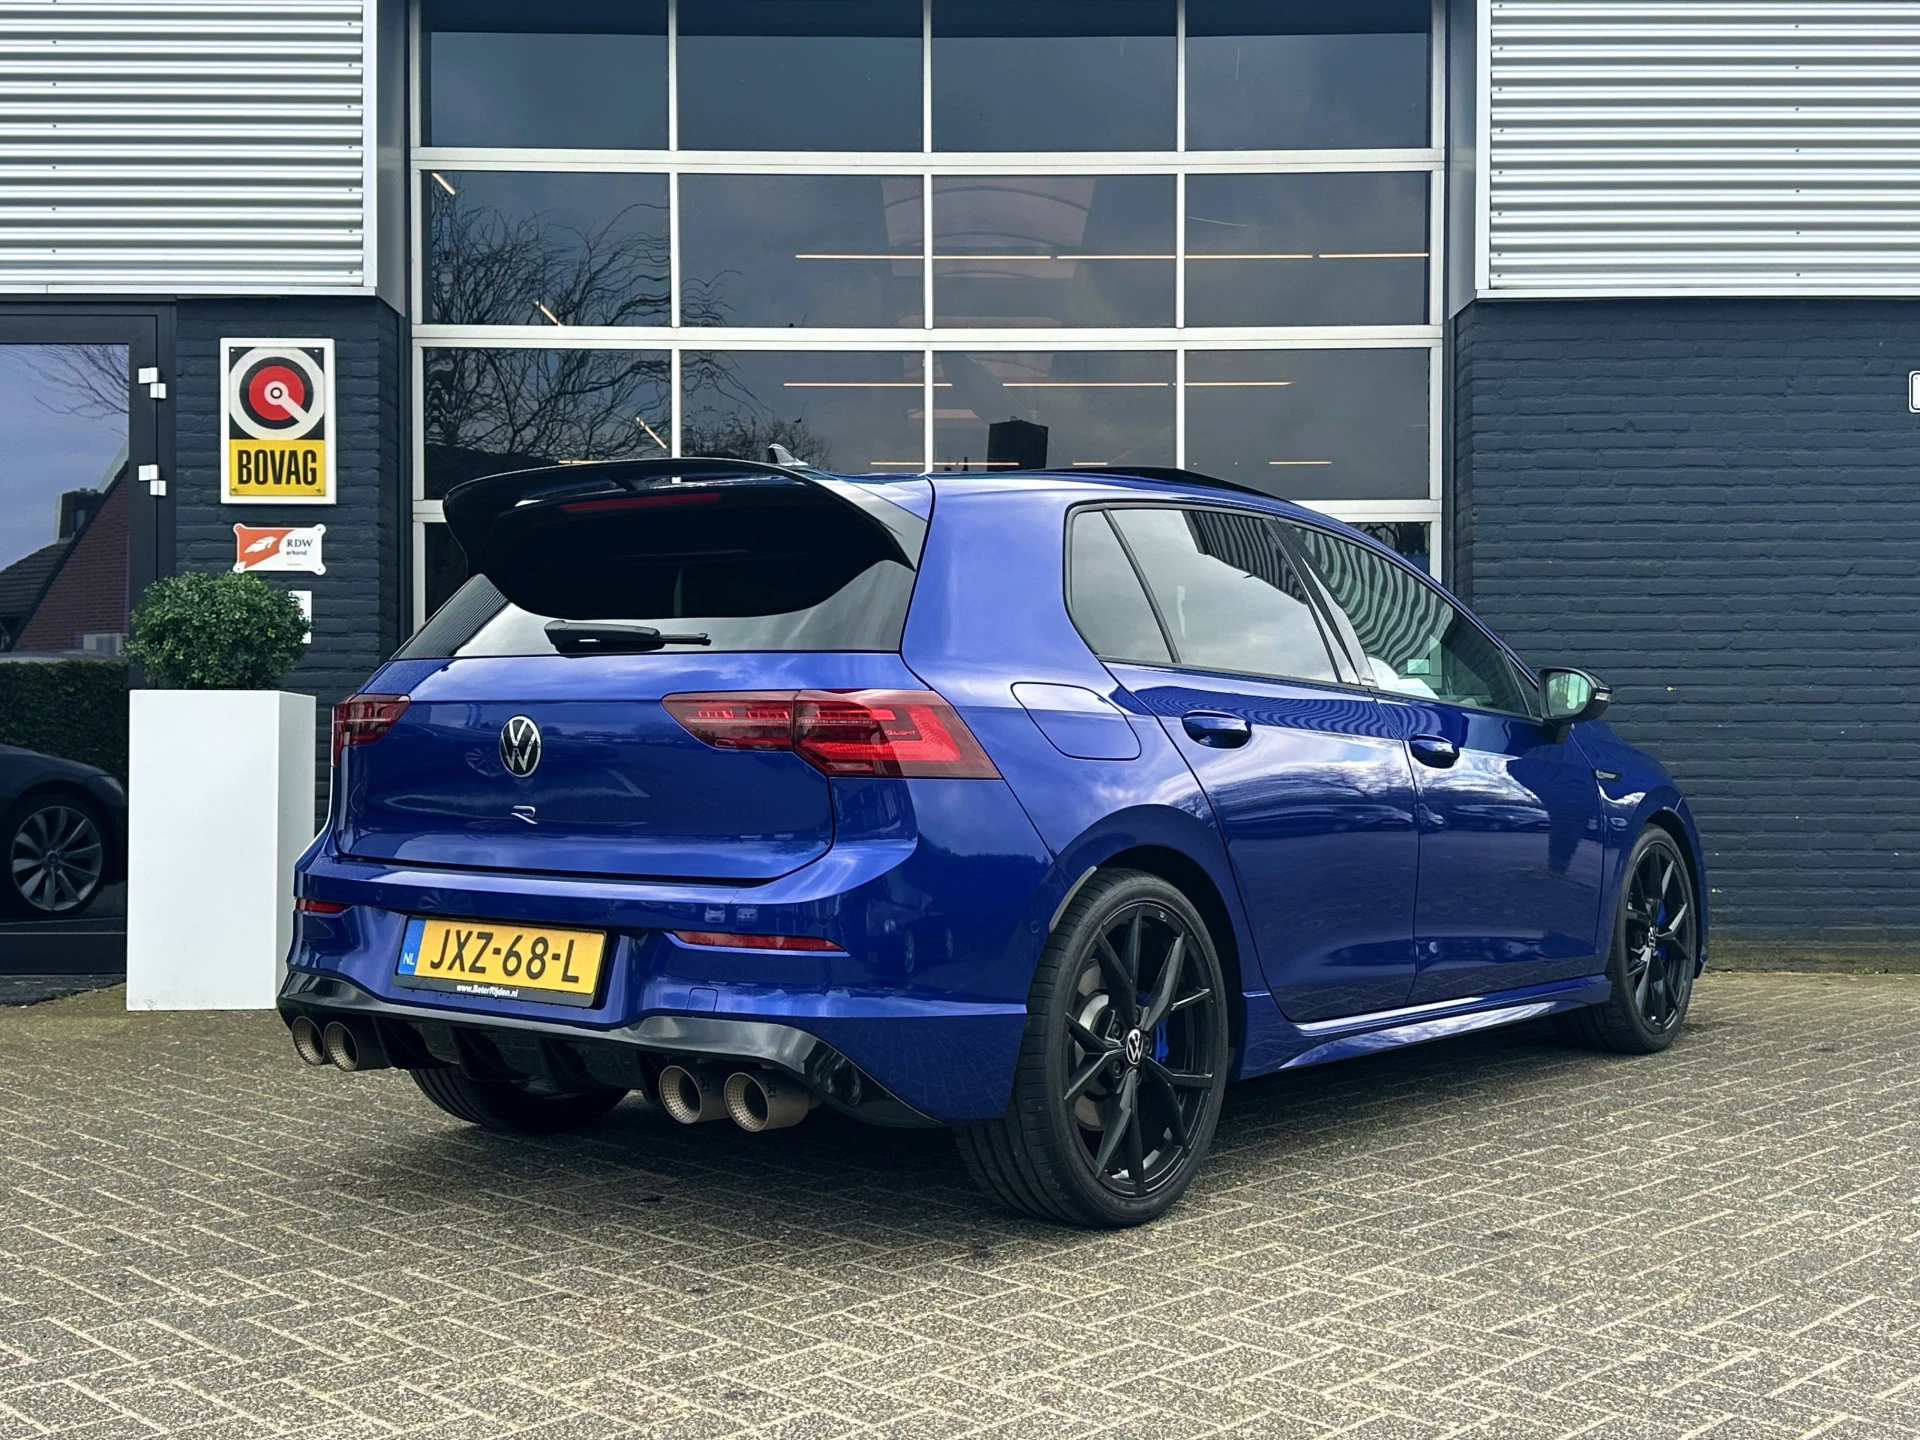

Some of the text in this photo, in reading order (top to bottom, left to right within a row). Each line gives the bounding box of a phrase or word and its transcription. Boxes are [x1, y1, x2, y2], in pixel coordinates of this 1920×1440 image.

[237, 449, 317, 485] BOVAG
[286, 538, 313, 547] RDW
[402, 952, 415, 965] NL
[430, 928, 579, 983] JXZ-68-L
[456, 984, 519, 997] www.BeterRijden.nl
